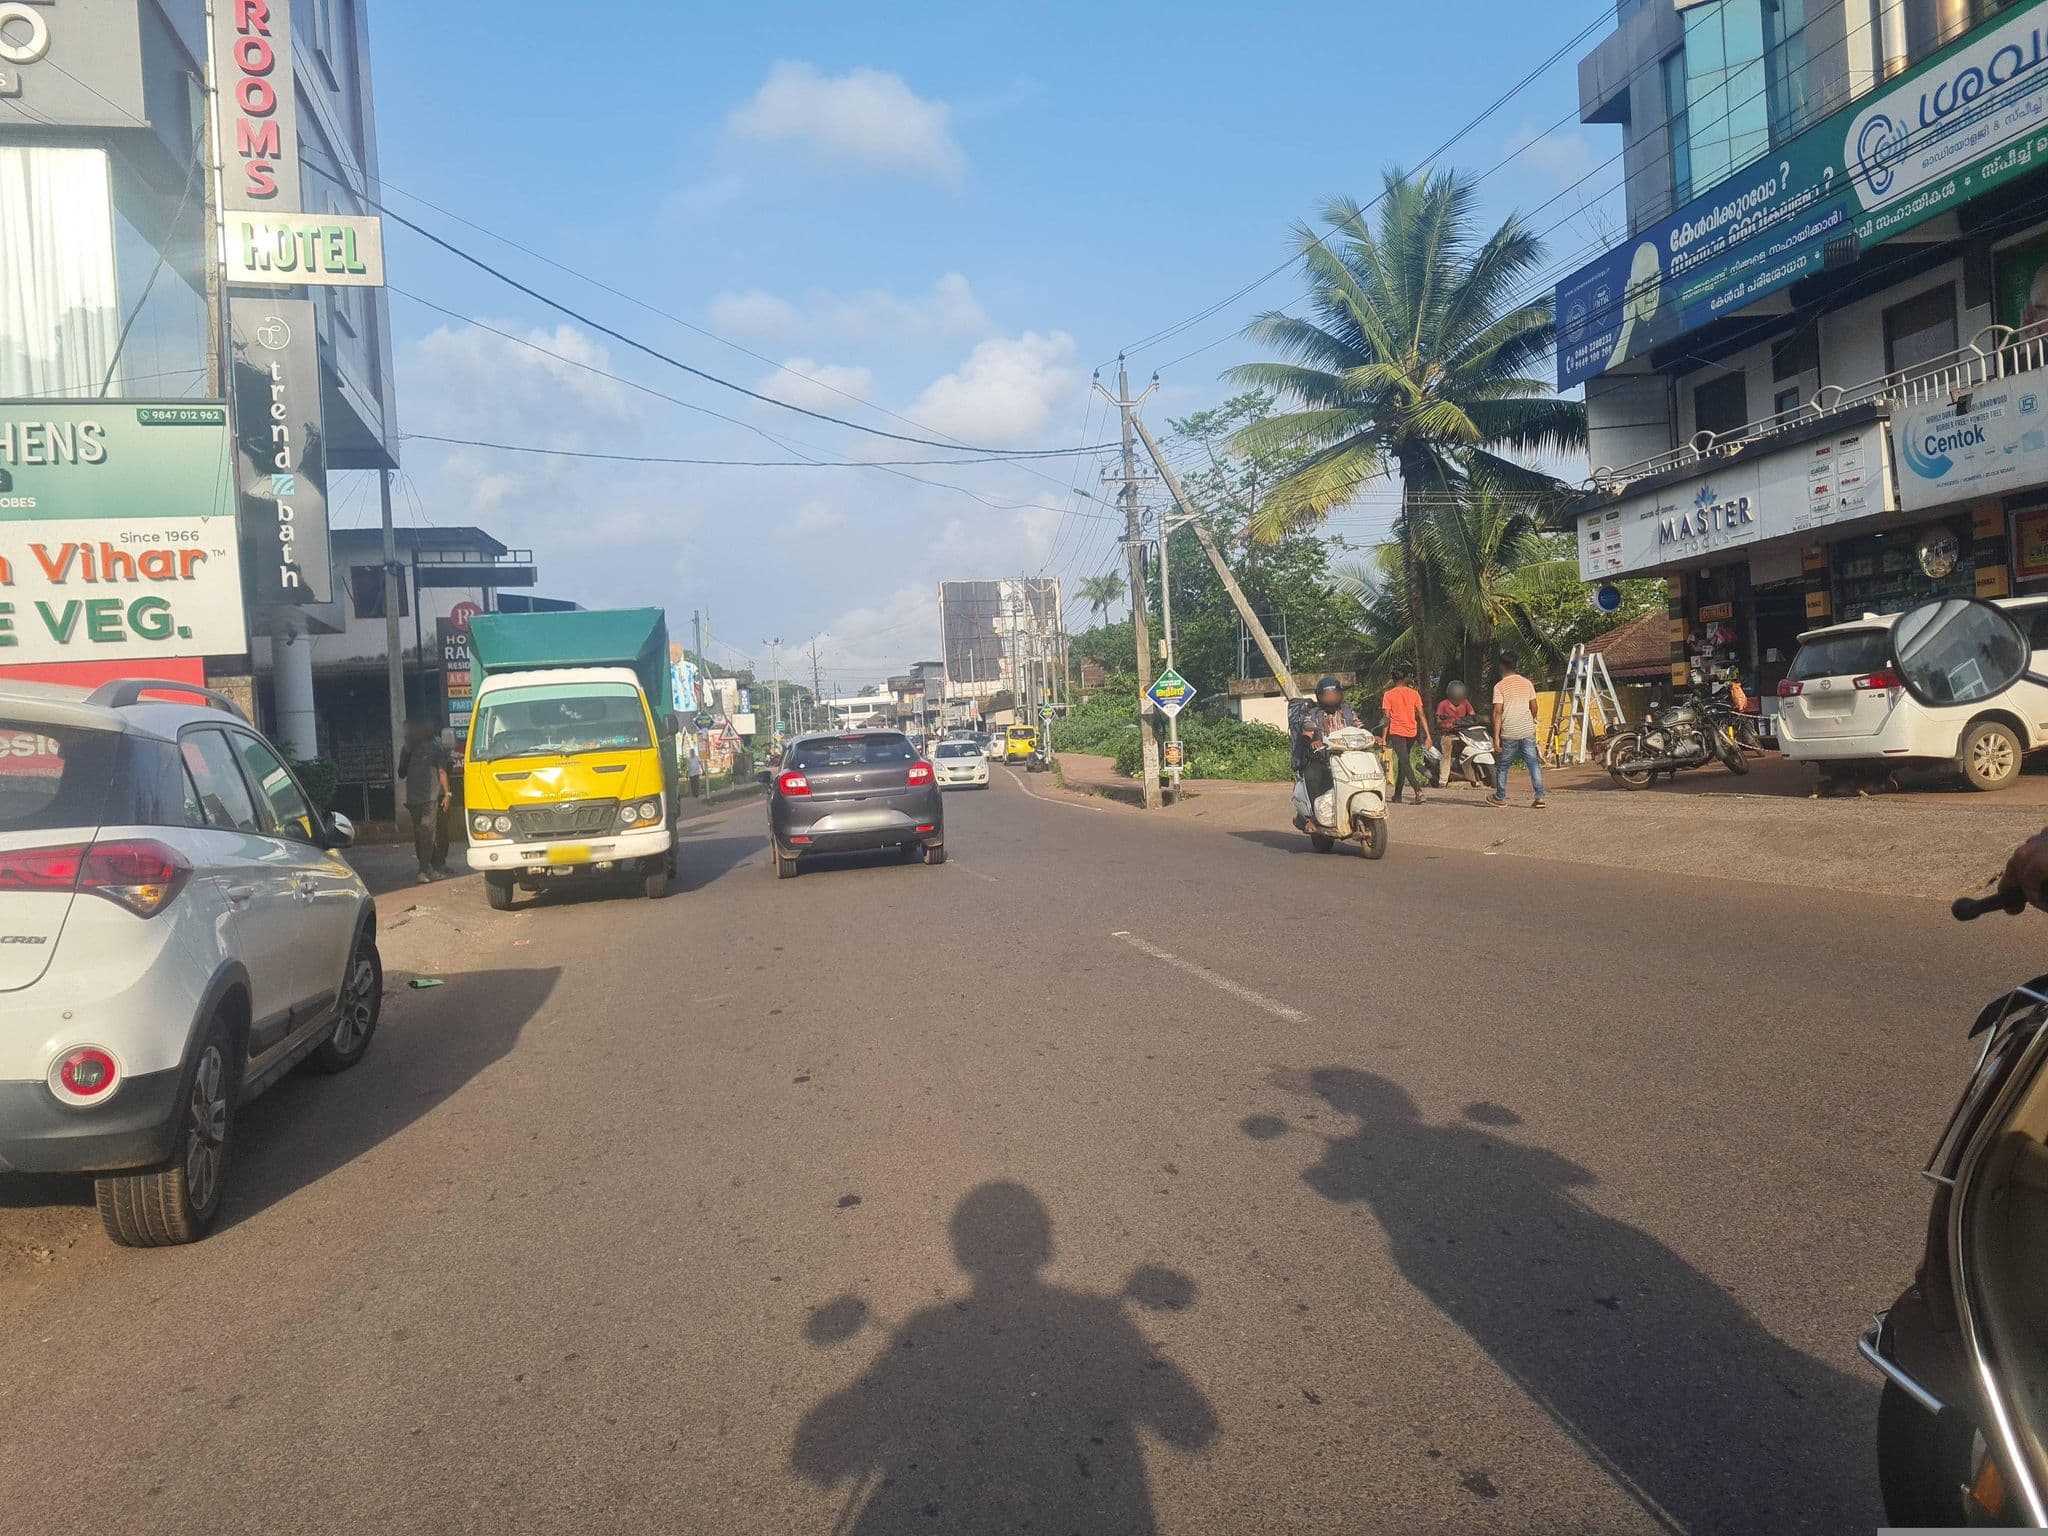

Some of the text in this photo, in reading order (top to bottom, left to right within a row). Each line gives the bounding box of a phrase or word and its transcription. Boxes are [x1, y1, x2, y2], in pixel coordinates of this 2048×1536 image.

[233, 0, 282, 199] ROOMS
[1919, 26, 2048, 129] ശ്രവ
[1670, 160, 1790, 252] കേൾവിക്കുറവോ ?
[241, 222, 366, 273] HOTEL
[1747, 255, 1807, 294] പരിശോധന
[152, 410, 220, 420] 9847 012 962
[270, 360, 292, 469] trend
[1925, 424, 1986, 456] Centok
[120, 530, 200, 543] Since 1966
[277, 500, 299, 588] bath
[1660, 496, 1754, 545] MASTER
[29, 541, 208, 584] Vihar
[35, 595, 193, 645] VEG.
[446, 634, 467, 645] HO
[447, 661, 471, 670] RESID
